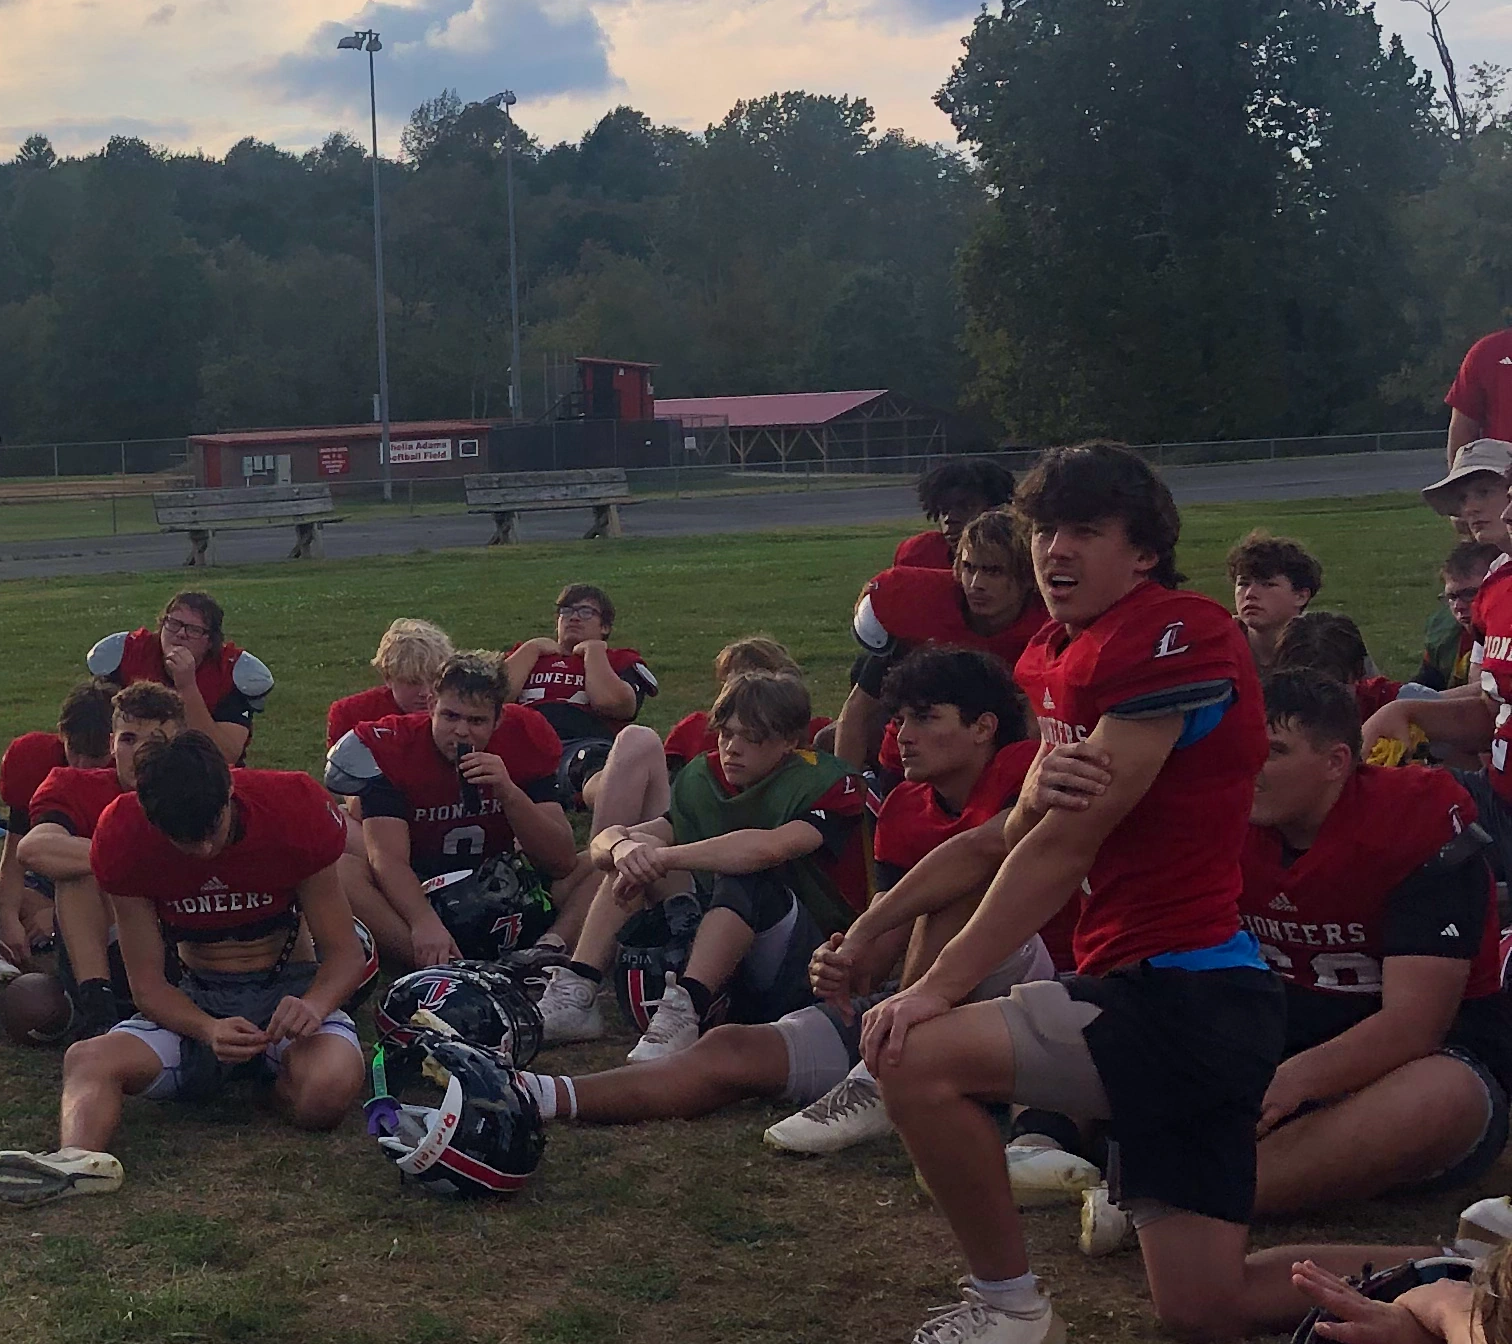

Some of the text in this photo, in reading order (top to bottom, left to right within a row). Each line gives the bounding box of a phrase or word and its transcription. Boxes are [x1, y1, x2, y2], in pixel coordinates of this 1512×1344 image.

[390, 451, 447, 461] oftball Field
[529, 672, 584, 687] IONEER
[414, 798, 502, 823] PIONER
[167, 891, 273, 914] IONEERS
